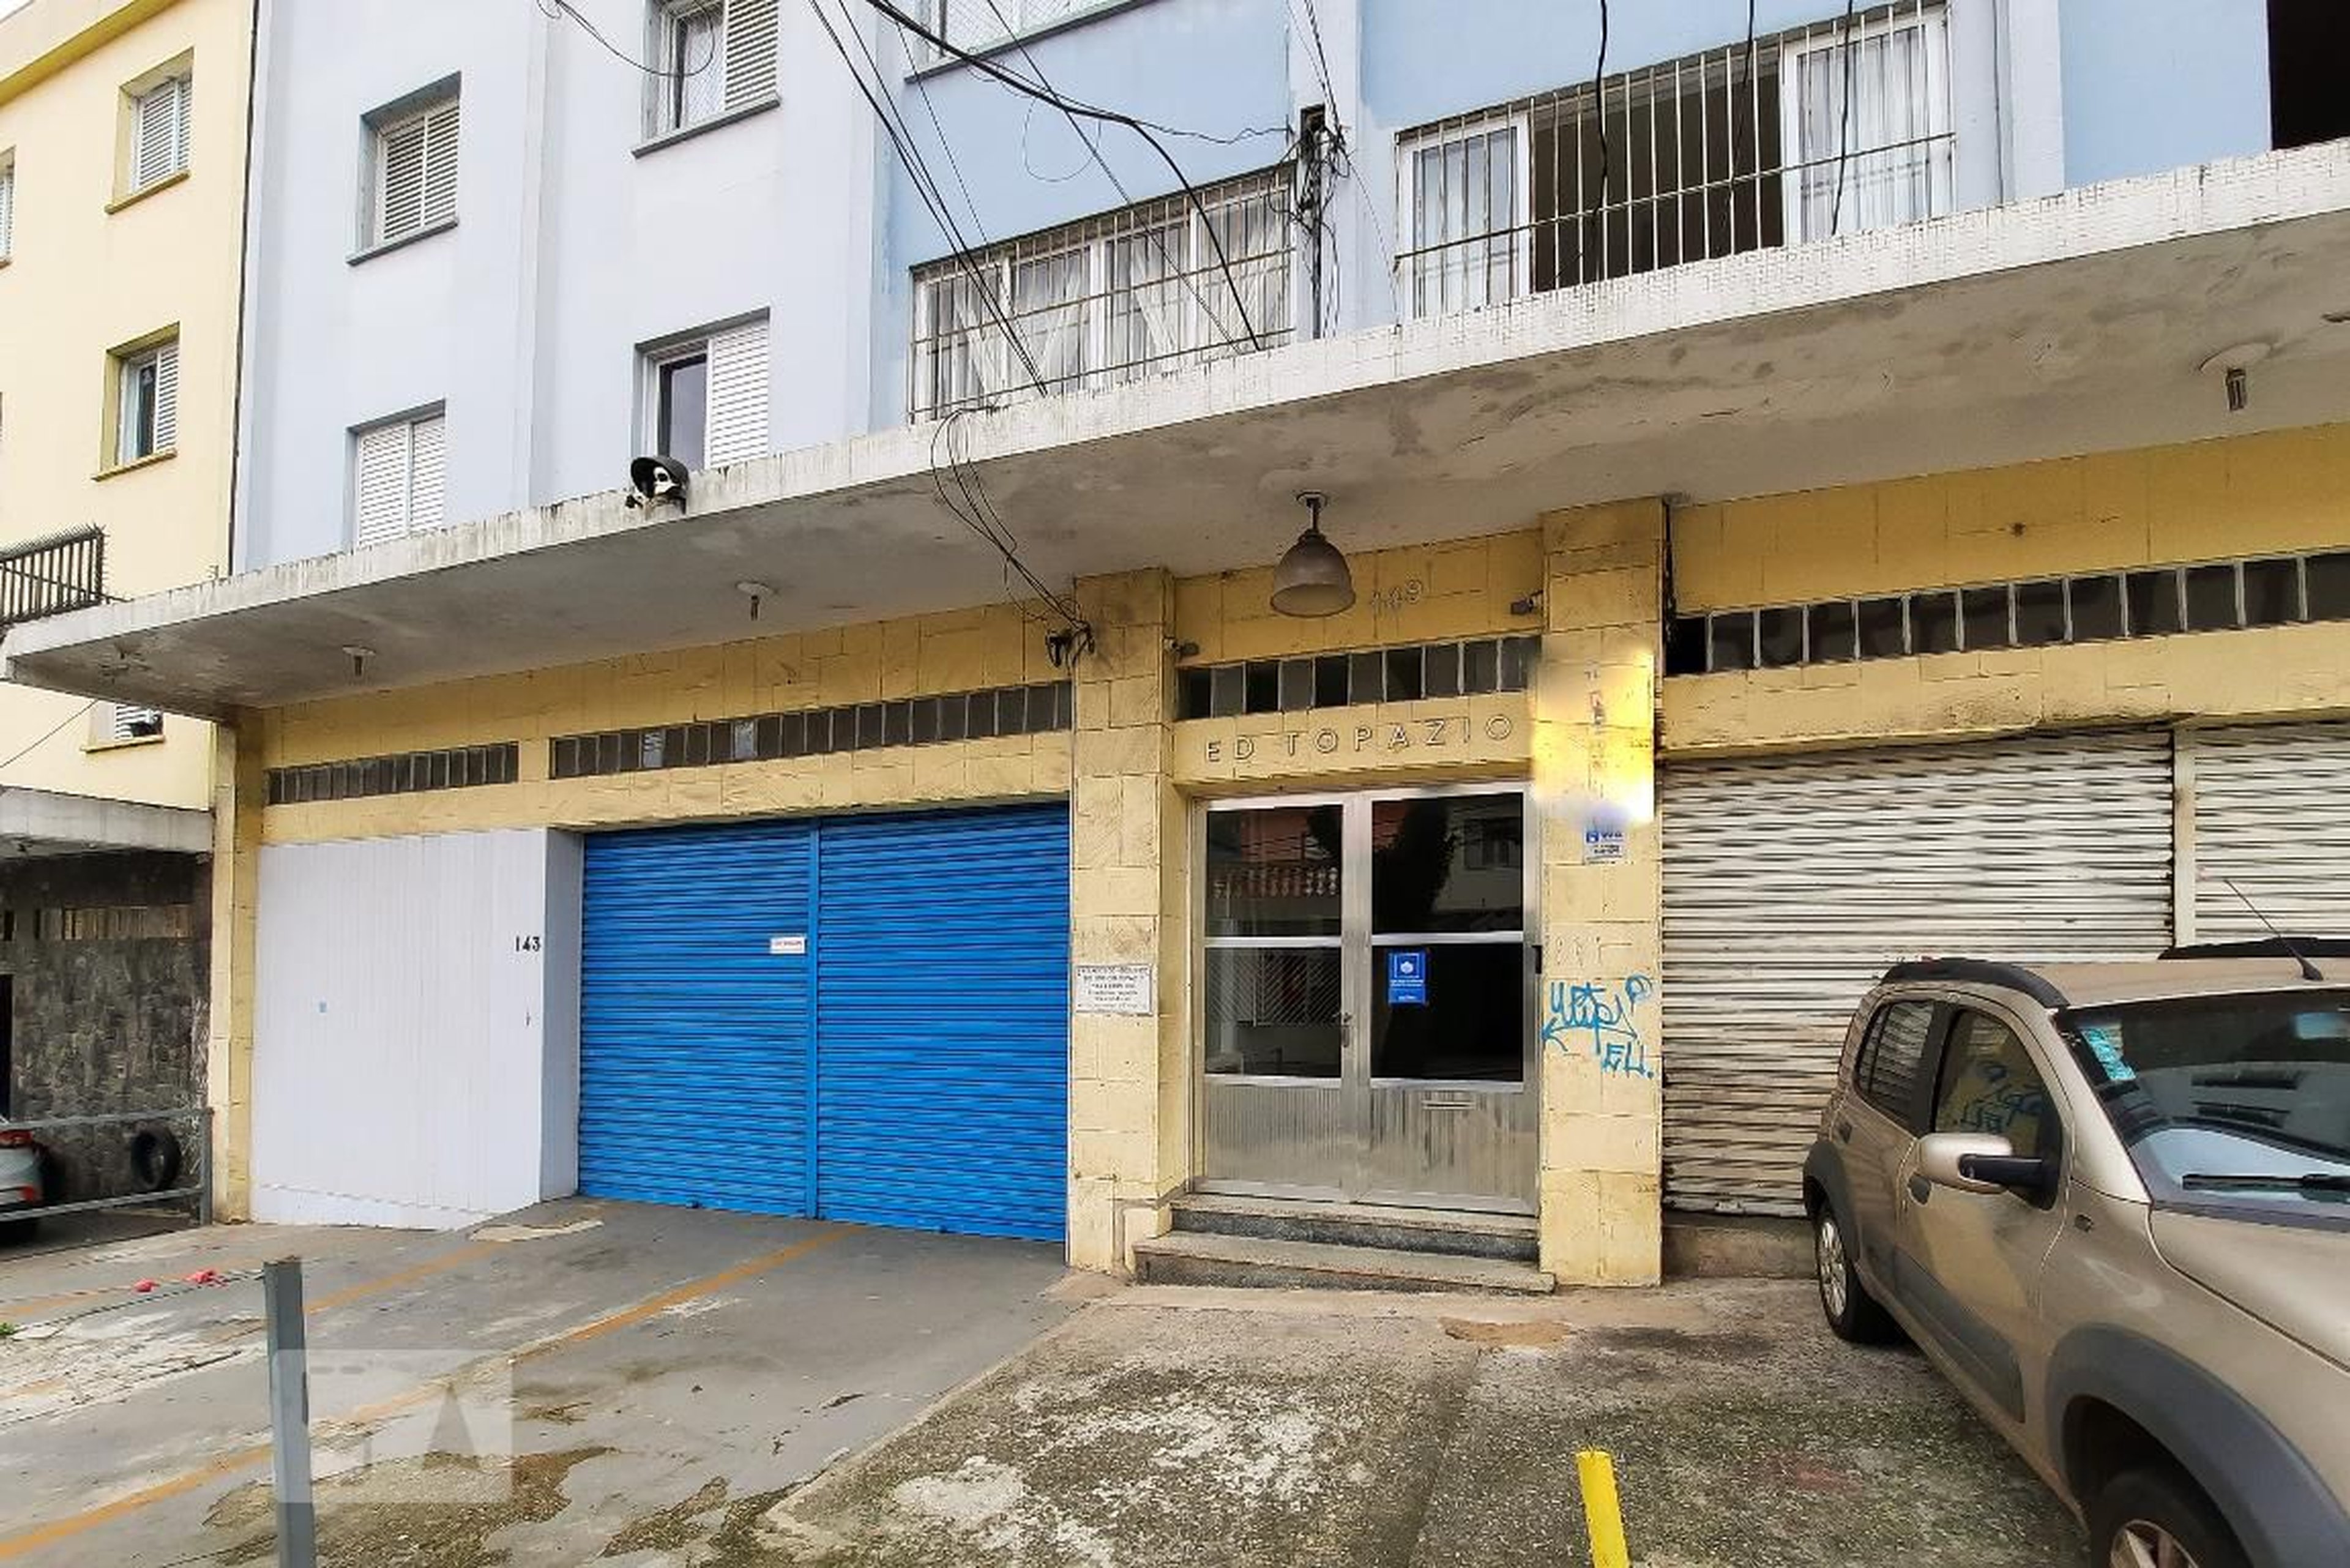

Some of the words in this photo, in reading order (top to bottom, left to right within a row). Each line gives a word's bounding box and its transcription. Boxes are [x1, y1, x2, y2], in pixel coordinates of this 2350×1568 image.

[1205, 735, 1255, 762] ED
[1286, 714, 1513, 756] TOPAZIO
[515, 936, 541, 952] 143
